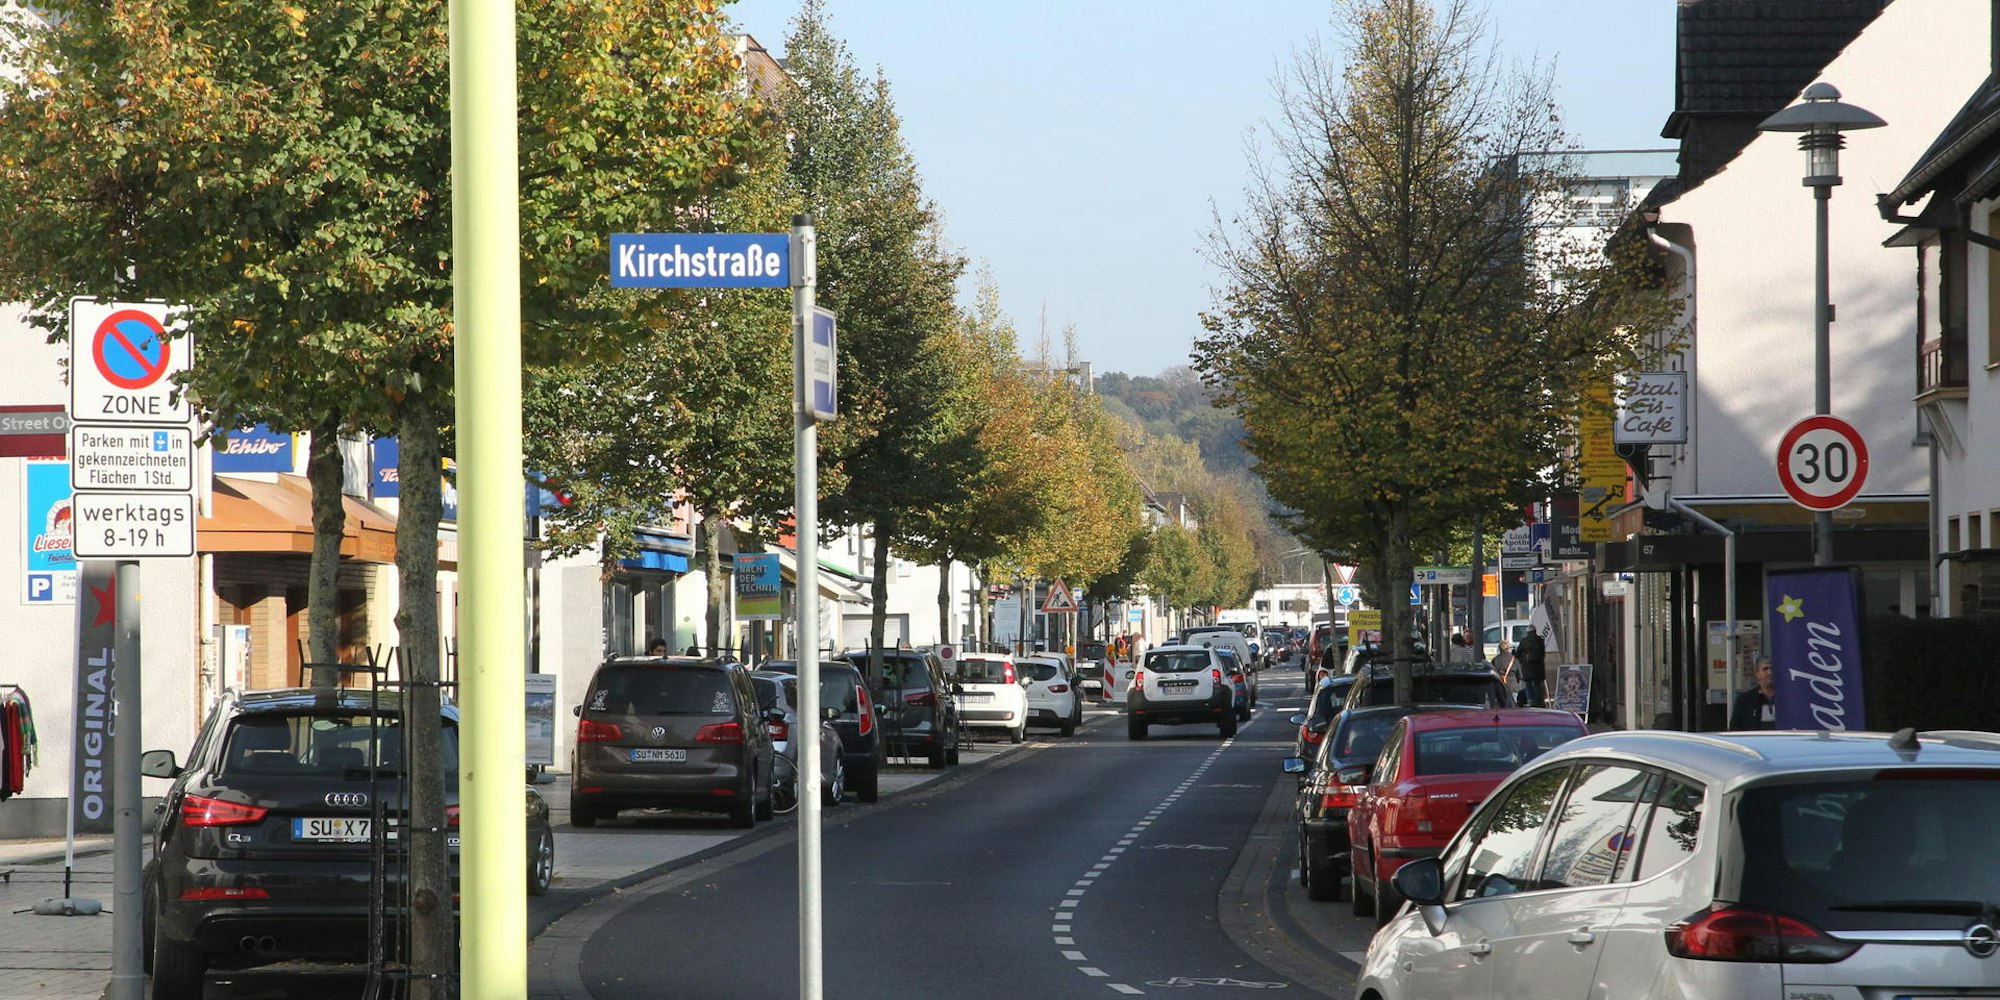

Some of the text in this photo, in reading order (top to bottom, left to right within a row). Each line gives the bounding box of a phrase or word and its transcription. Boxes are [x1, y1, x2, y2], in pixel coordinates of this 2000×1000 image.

[618, 243, 781, 278] Kirchstraße
[102, 395, 161, 415] ZONE
[1631, 398, 1674, 414] Eis-
[2, 416, 49, 430] Street
[1623, 416, 1675, 437] Café
[82, 433, 182, 449] Parken mit in
[225, 438, 287, 455] Tchibo
[78, 452, 187, 469] gekennzeichneten
[1796, 442, 1849, 483] 30
[90, 469, 137, 484] Flächen
[83, 503, 184, 526] werktags
[104, 528, 164, 547] 8-19 h
[1643, 545, 1655, 555] 67
[740, 574, 756, 582] DER
[32, 578, 50, 598] P
[740, 583, 779, 592] TECHNIK
[1789, 622, 1847, 731] aden
[82, 647, 108, 820] ORIGINAL
[310, 820, 332, 836] SU
[344, 820, 355, 836] X
